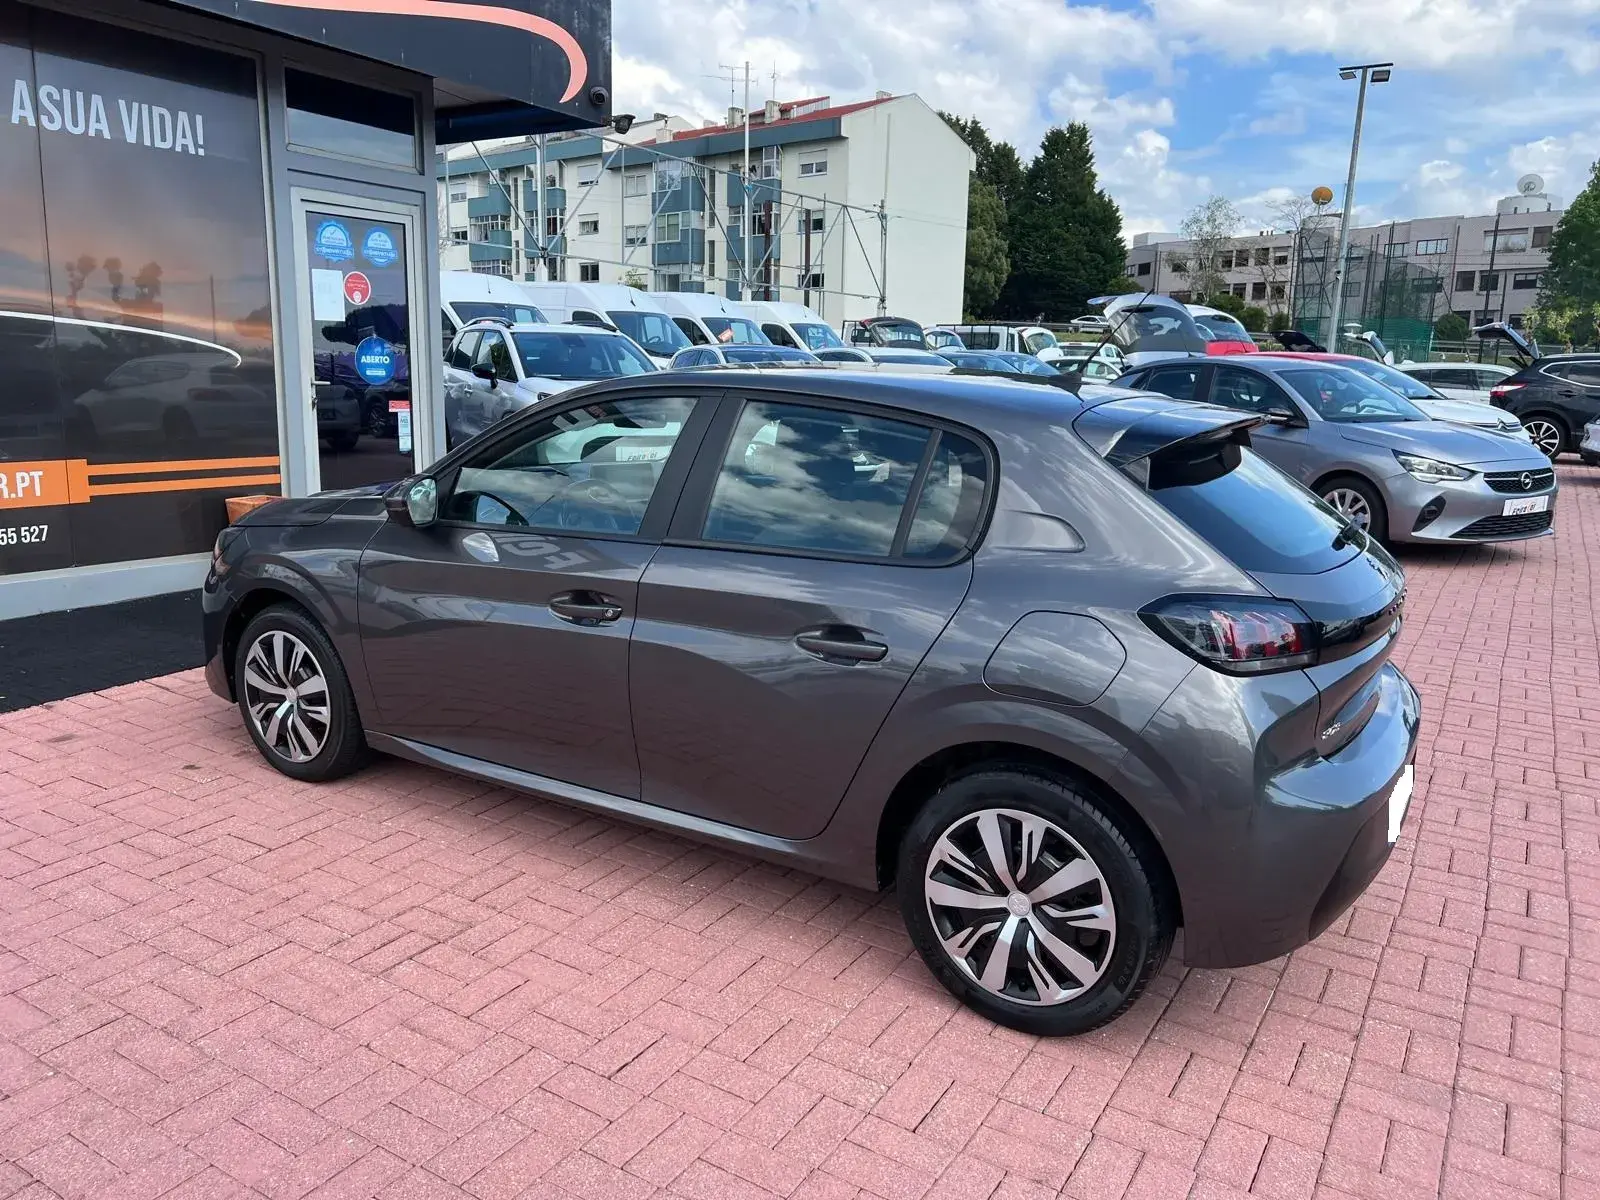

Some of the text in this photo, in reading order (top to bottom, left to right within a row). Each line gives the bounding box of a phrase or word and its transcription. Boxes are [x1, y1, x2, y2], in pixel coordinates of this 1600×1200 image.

[118, 99, 205, 156] VIDA!
[361, 355, 390, 364] ABERTO
[20, 524, 48, 544] 527
